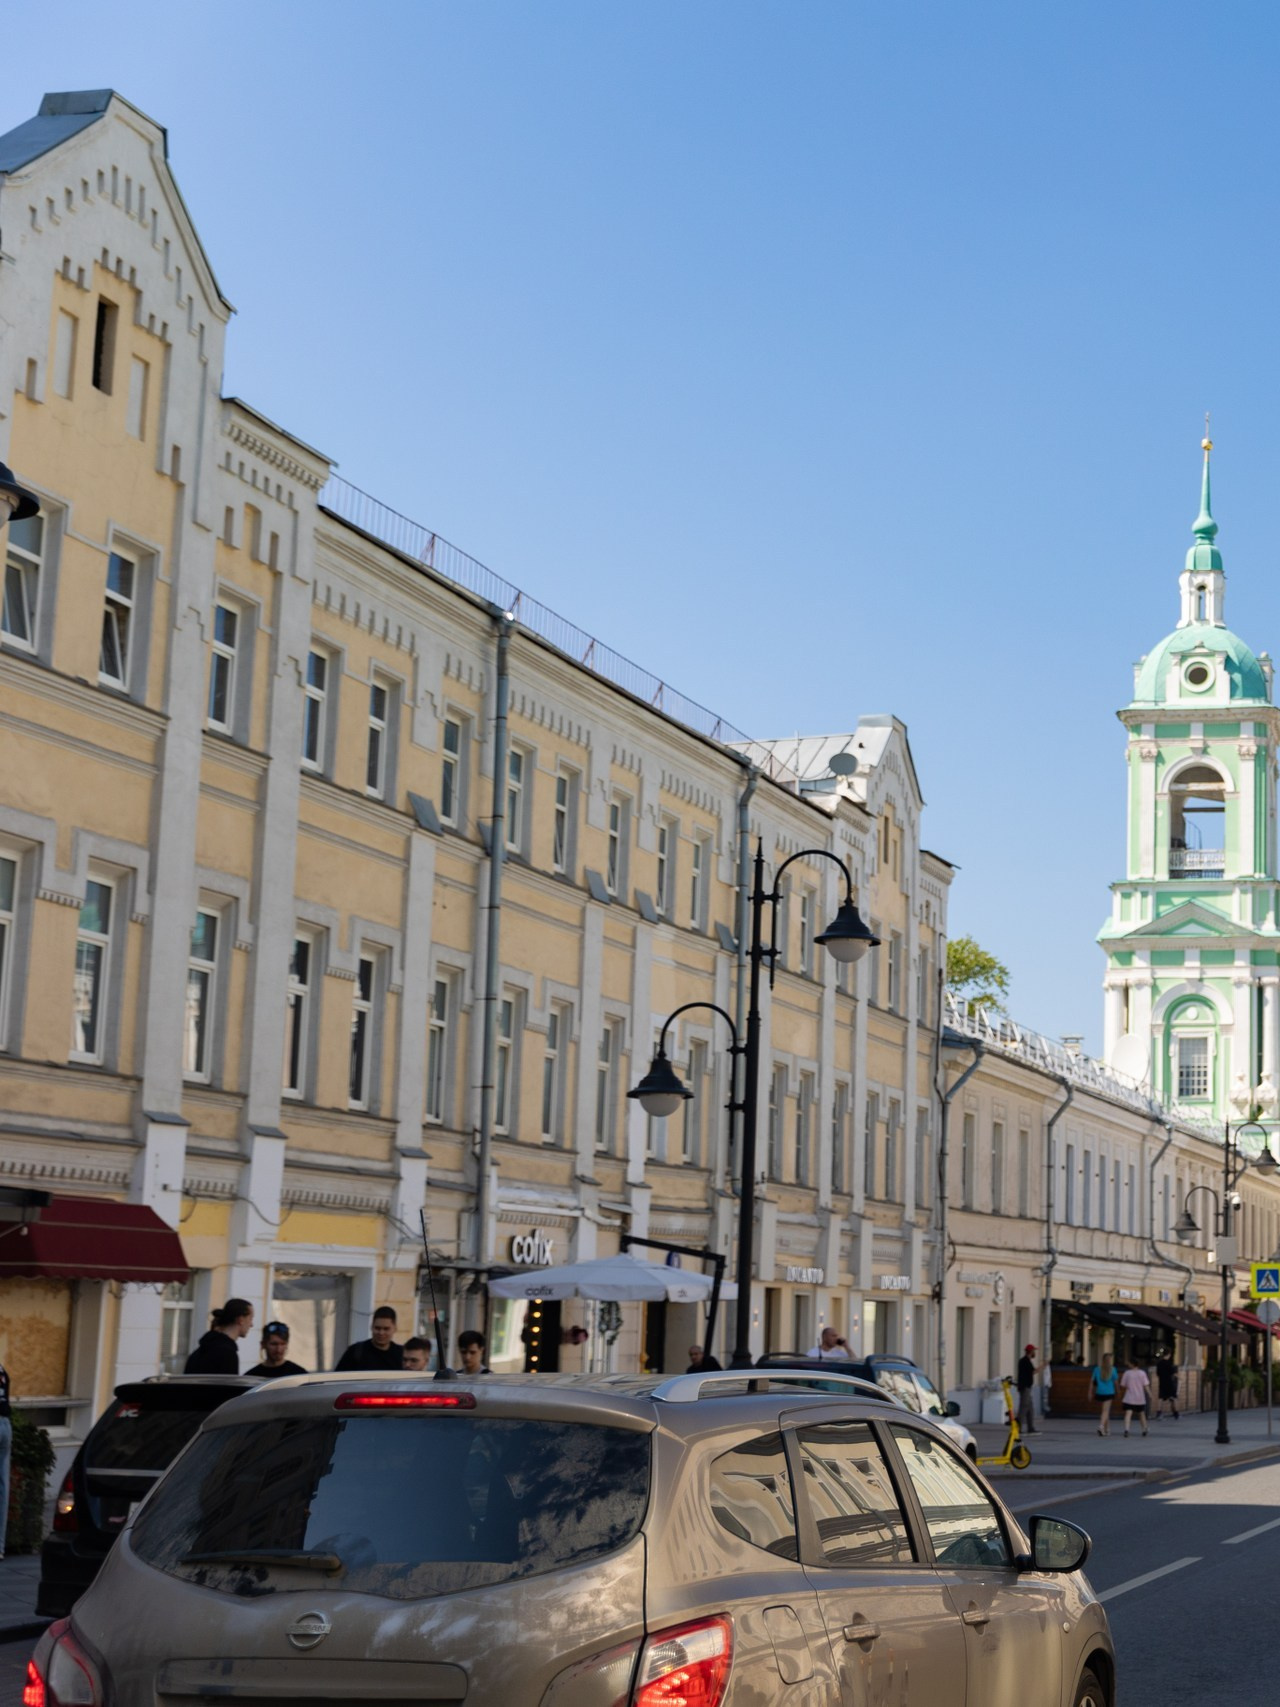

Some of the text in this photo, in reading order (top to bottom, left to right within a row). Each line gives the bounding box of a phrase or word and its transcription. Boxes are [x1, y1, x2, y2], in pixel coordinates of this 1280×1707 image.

[511, 1228, 554, 1266] cofix
[786, 1265, 824, 1284] INCANTO
[524, 1285, 554, 1297] cofix
